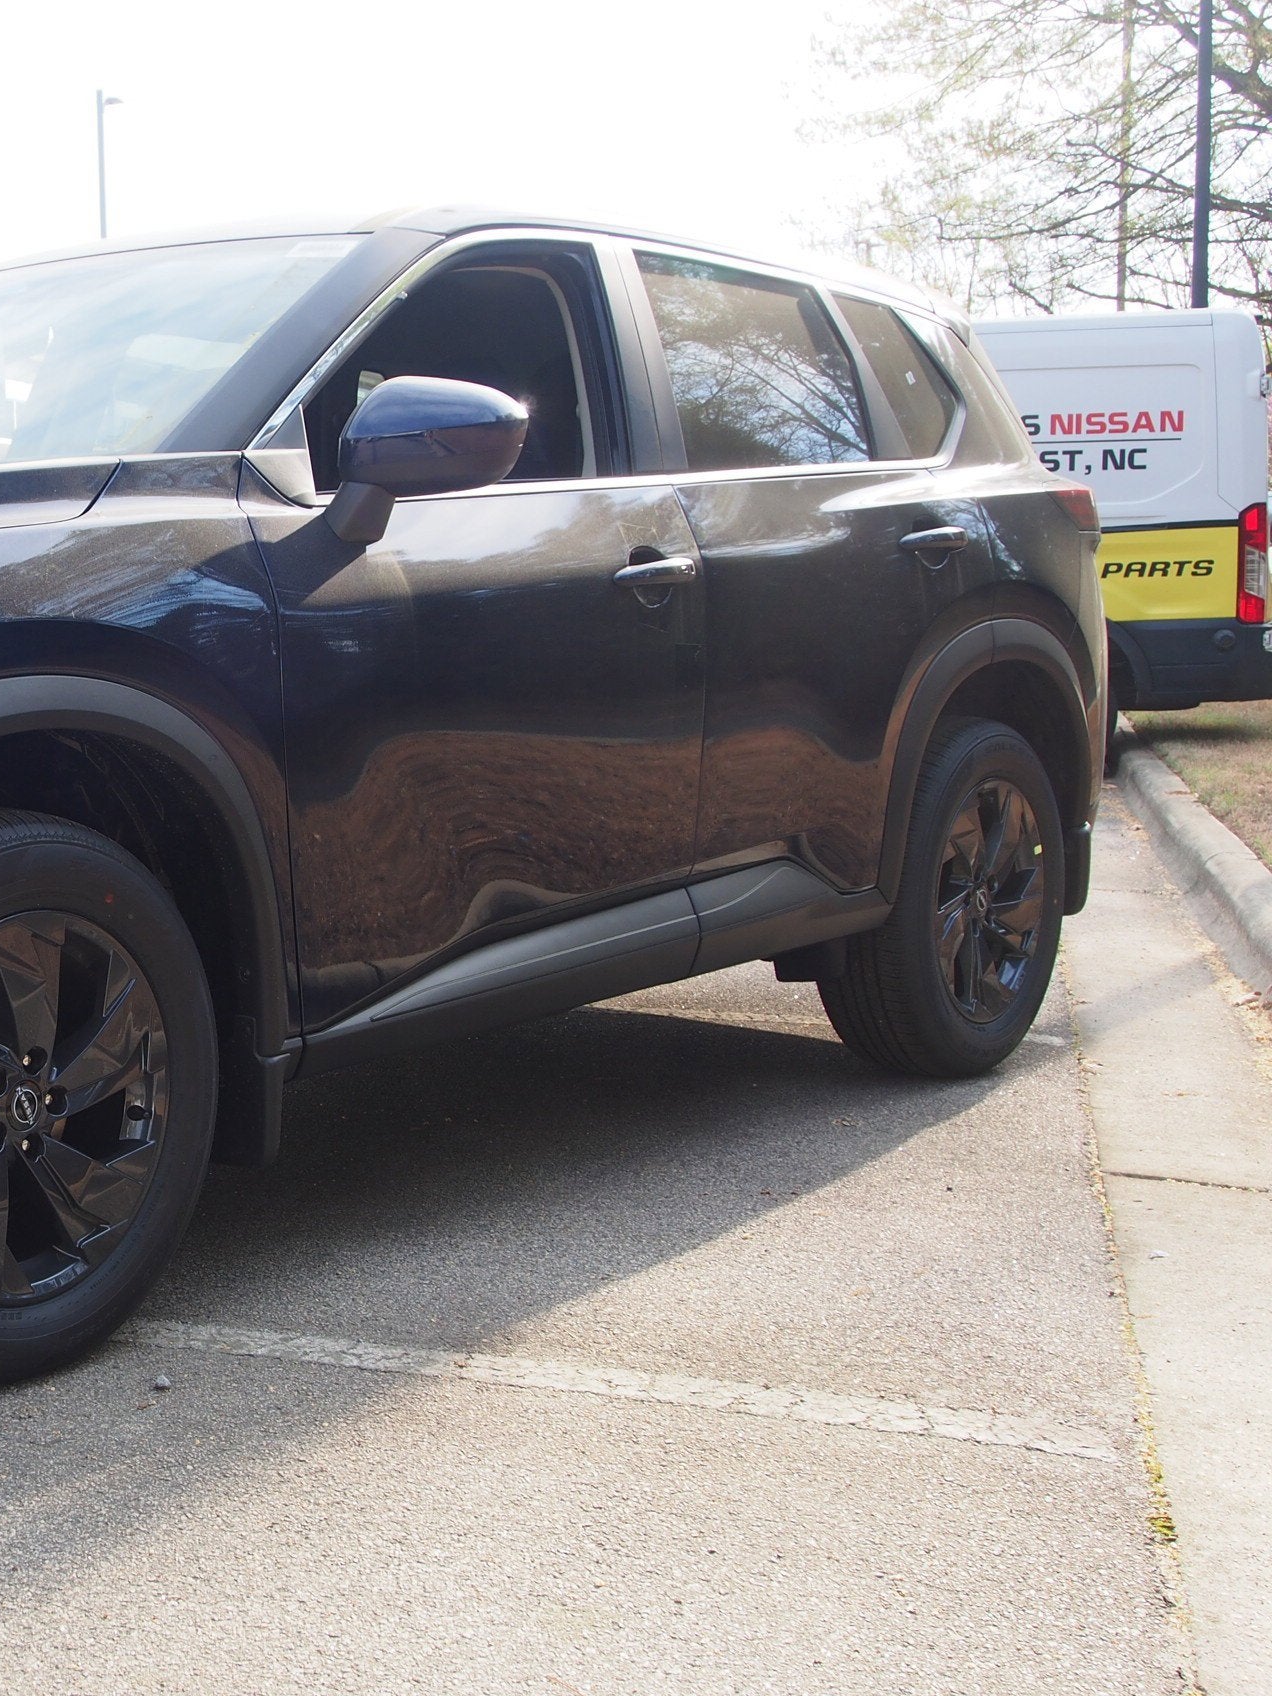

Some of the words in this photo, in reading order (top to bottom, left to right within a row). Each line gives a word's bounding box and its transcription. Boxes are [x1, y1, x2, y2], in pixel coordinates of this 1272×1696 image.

[1049, 410, 1184, 435] NISSAN
[1101, 448, 1148, 470] NC
[1100, 560, 1215, 578] PARTS
[15, 1085, 37, 1126] NISSAN
